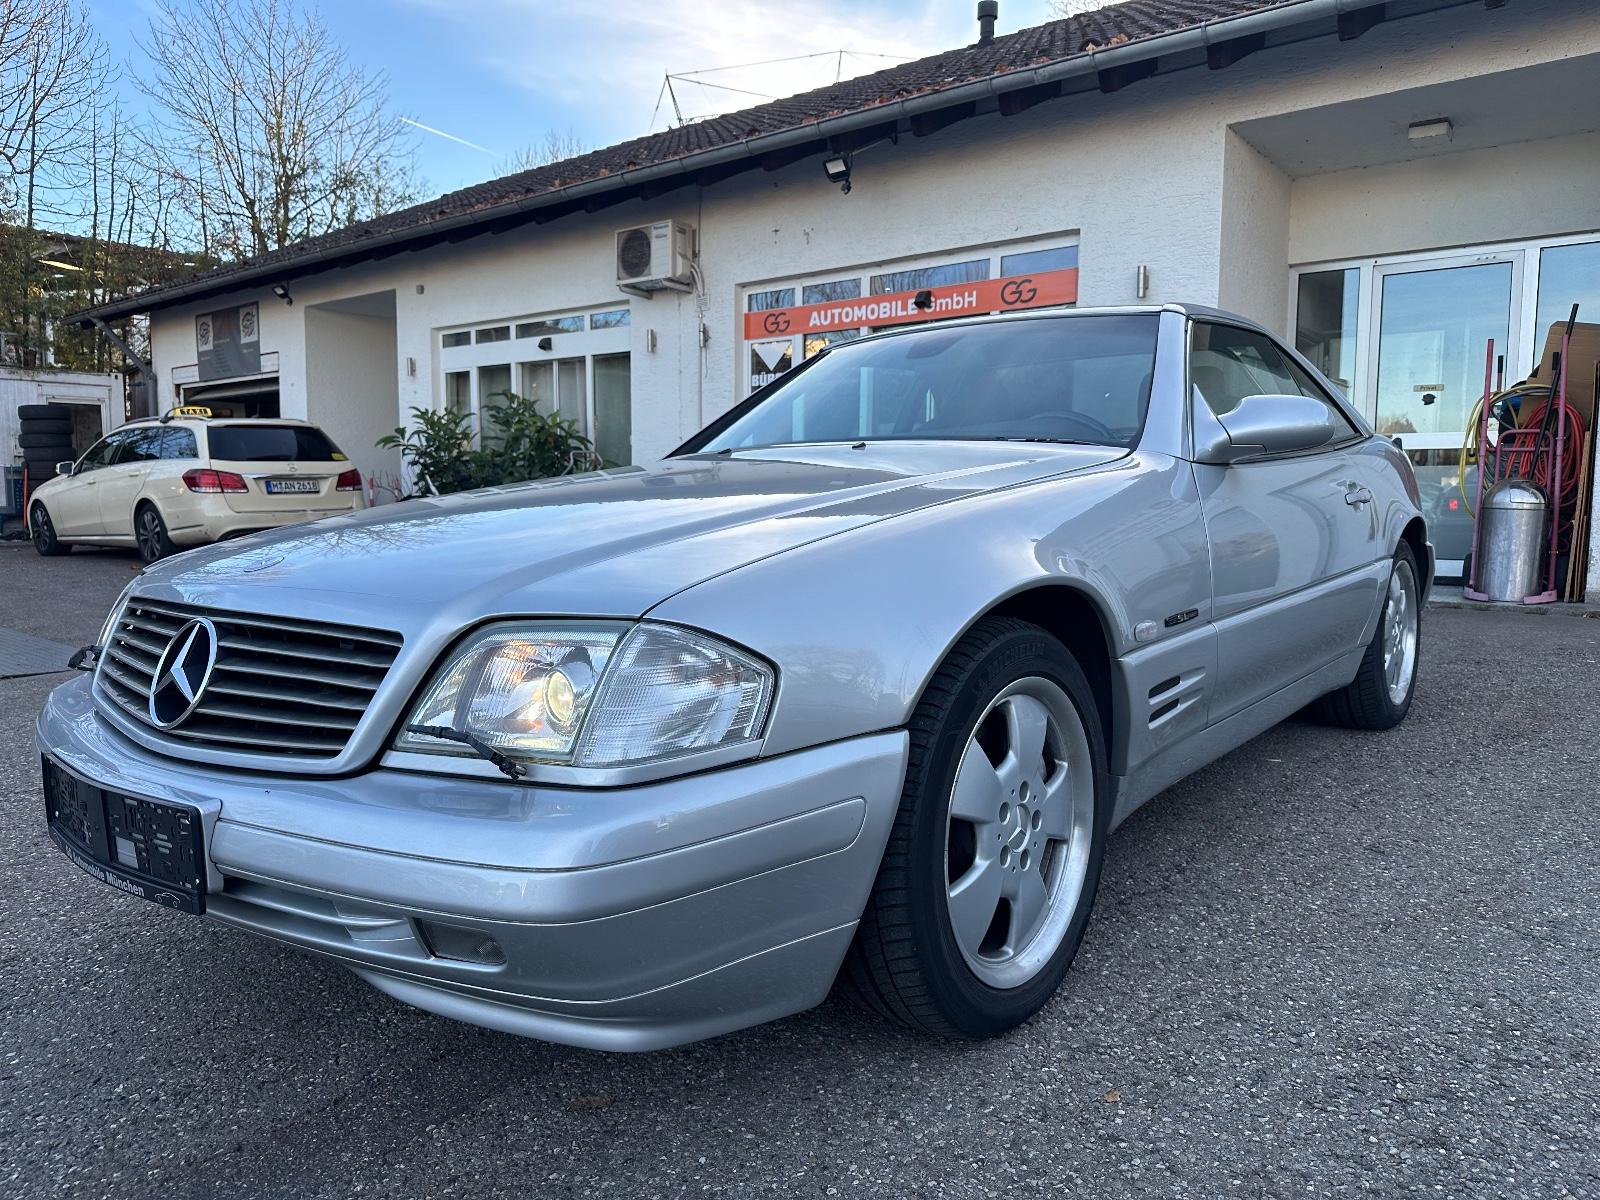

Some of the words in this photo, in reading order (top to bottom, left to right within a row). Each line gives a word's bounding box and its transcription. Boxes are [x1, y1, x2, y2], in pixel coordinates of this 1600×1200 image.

[809, 298, 918, 327] AUTOMOBILE
[751, 371, 784, 387] BÜR
[105, 872, 145, 897] München
